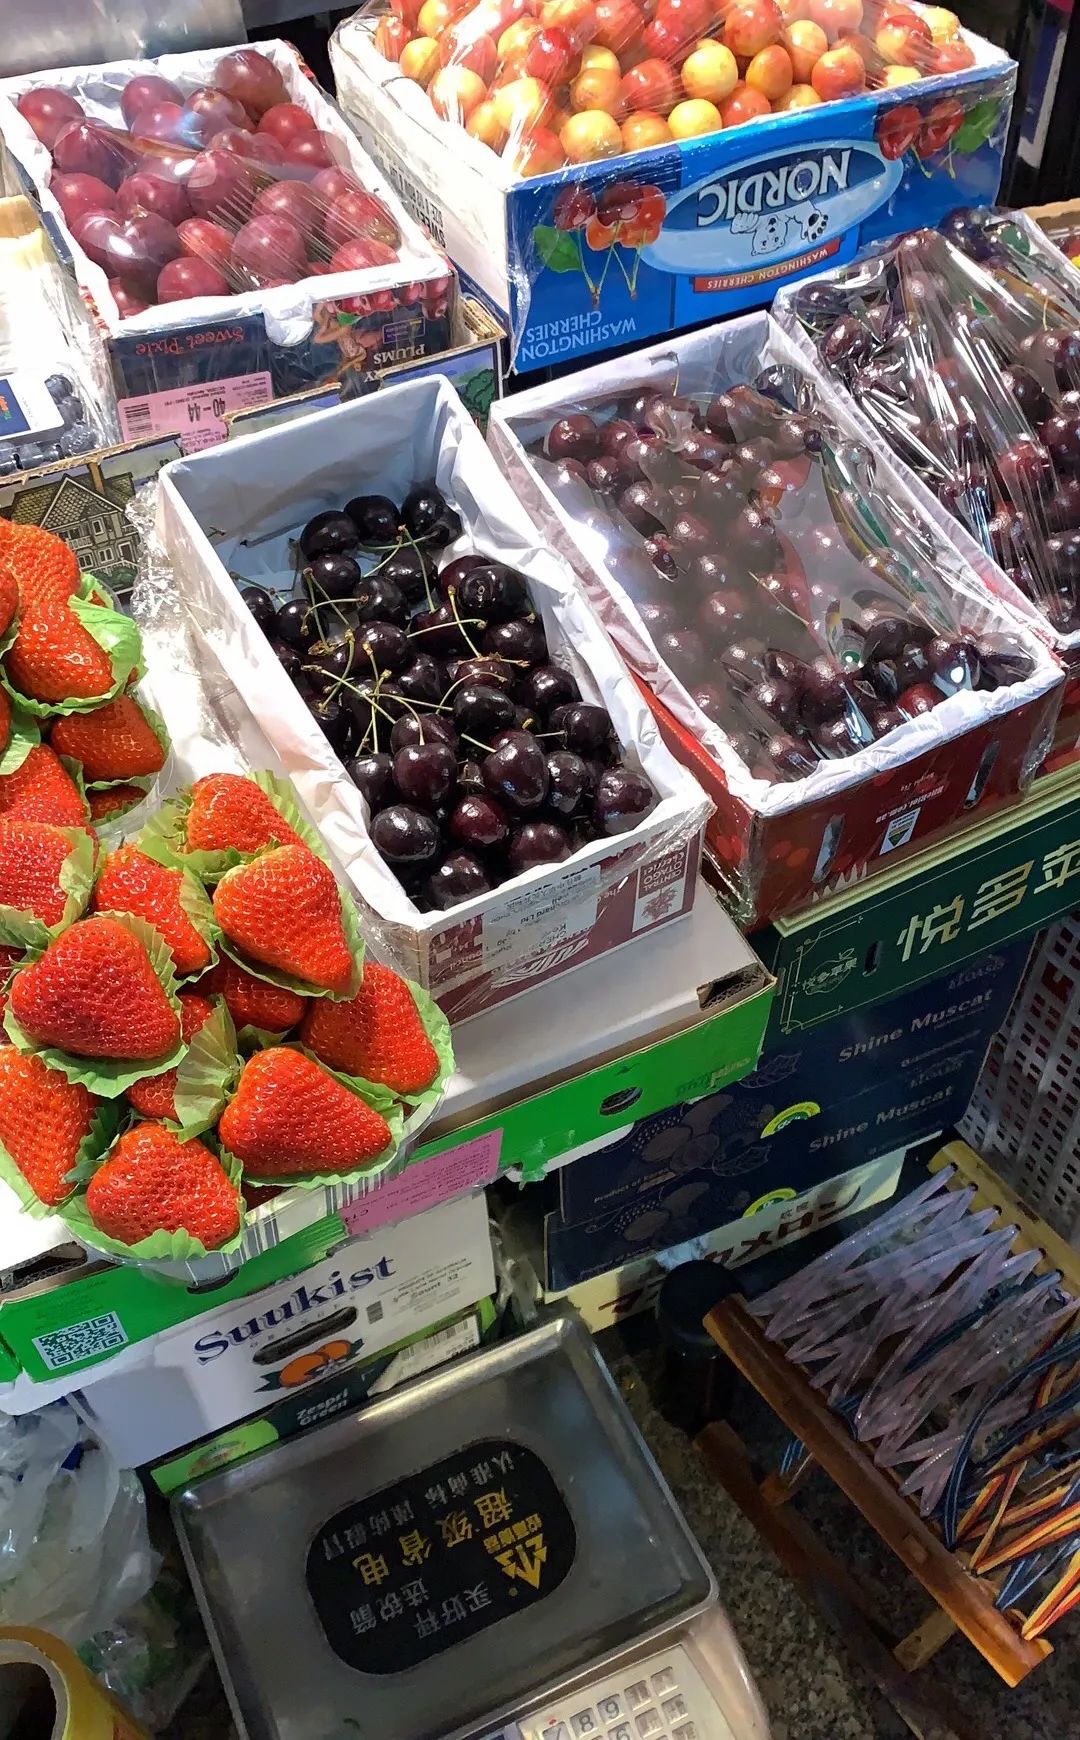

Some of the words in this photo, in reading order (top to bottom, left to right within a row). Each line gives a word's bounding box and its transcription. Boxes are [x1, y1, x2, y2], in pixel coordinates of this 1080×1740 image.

[697, 150, 855, 227] NORDIC
[759, 247, 829, 280] WASHINGTON
[707, 275, 756, 290] CHERRIES
[187, 326, 245, 349] Sweet
[522, 317, 637, 363] WASHINGTON
[527, 310, 603, 340] CHERRIES
[136, 337, 185, 355] Pixie
[373, 343, 425, 365] PLUMS
[643, 859, 683, 885] OTAGO
[643, 868, 682, 892] CENTRAL
[838, 1027, 904, 1063] Shine
[910, 989, 993, 1033] Muscat
[808, 1121, 869, 1153] Shine
[876, 1086, 953, 1126] Muscat
[598, 1186, 861, 1313] マクメロン
[297, 1388, 348, 1421] Zespri
[300, 1400, 347, 1427] Green
[352, 1485, 514, 1586] 超级省电
[349, 1576, 431, 1636] 选锐箭
[414, 1580, 493, 1640] 买好秤
[579, 1714, 594, 1732] 8
[605, 1700, 620, 1719] 9
